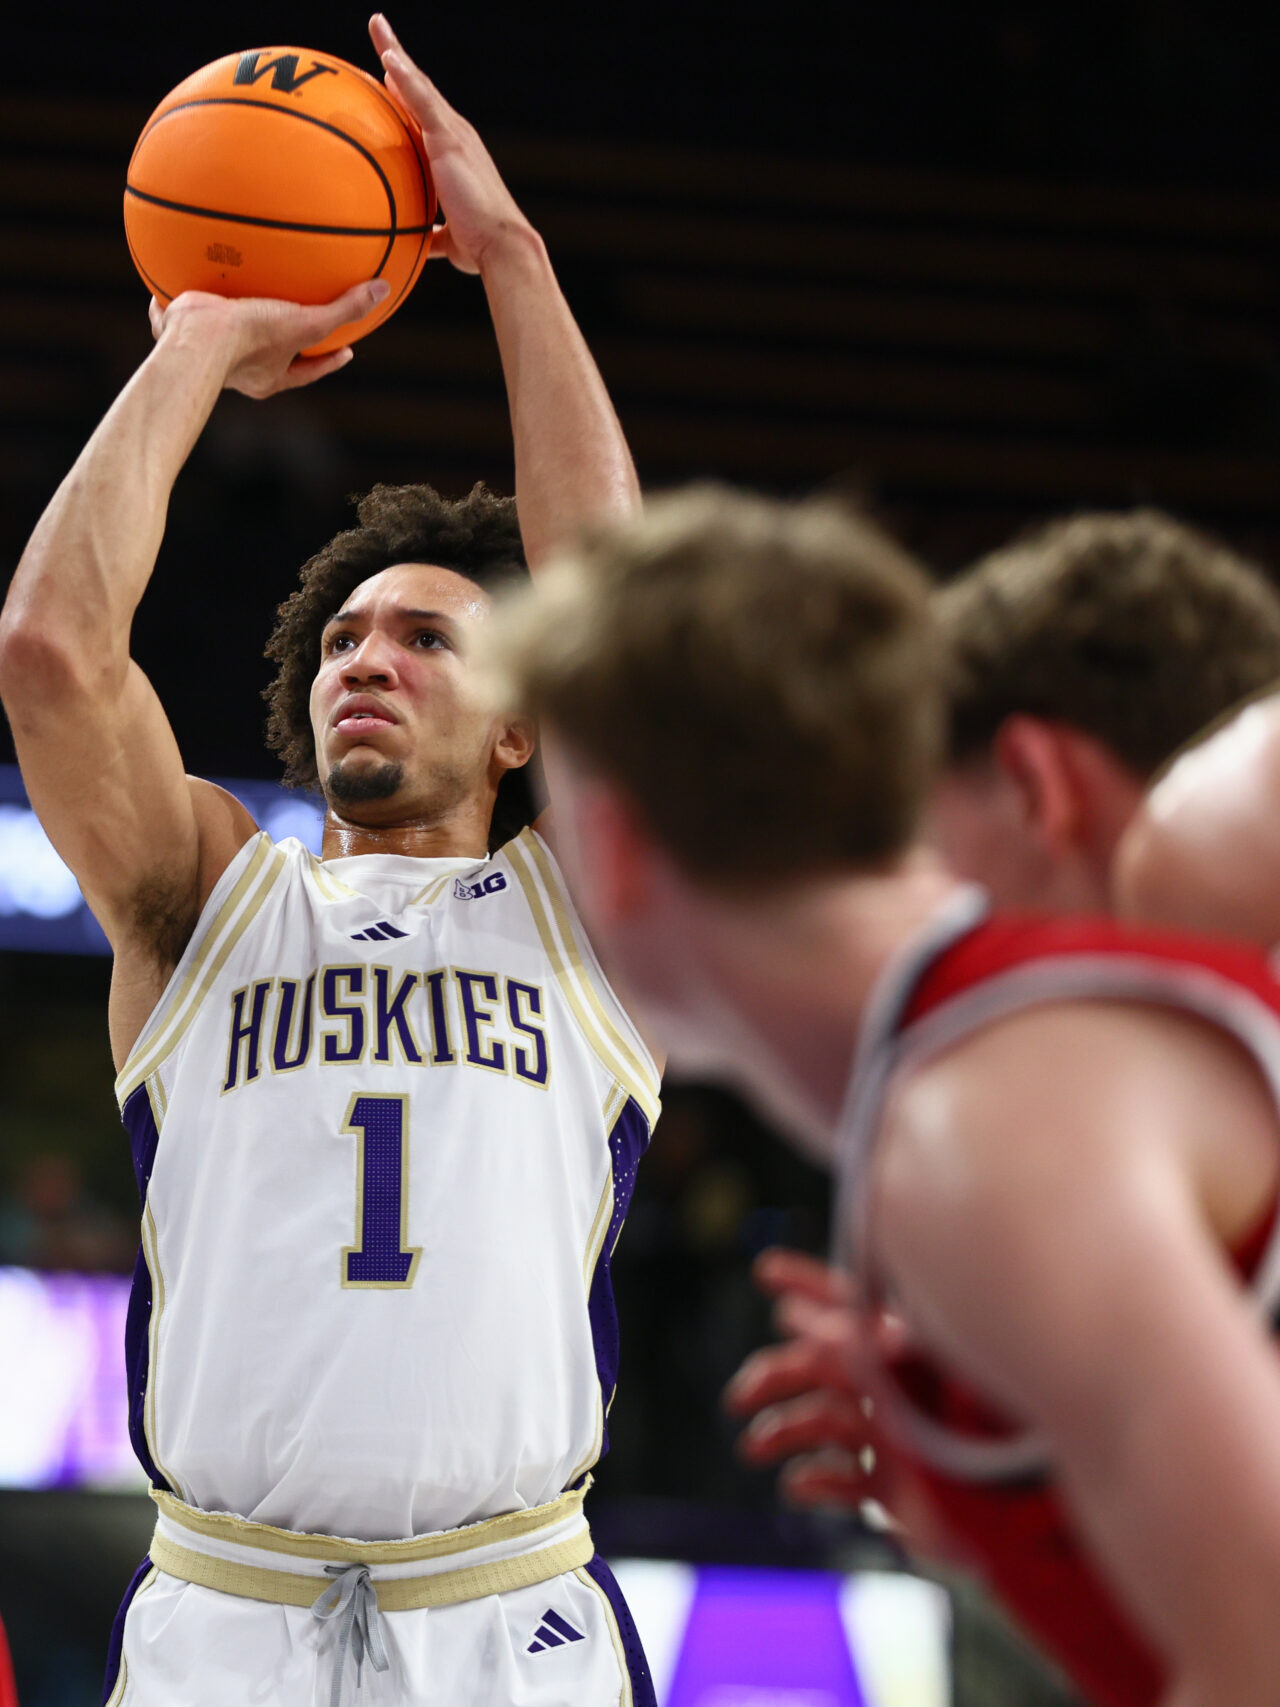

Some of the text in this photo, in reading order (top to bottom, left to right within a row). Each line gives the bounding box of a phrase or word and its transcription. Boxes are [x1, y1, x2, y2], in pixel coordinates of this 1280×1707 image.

[233, 52, 339, 94] W
[221, 963, 550, 1097] HUSKIES
[339, 1092, 423, 1289] 1
